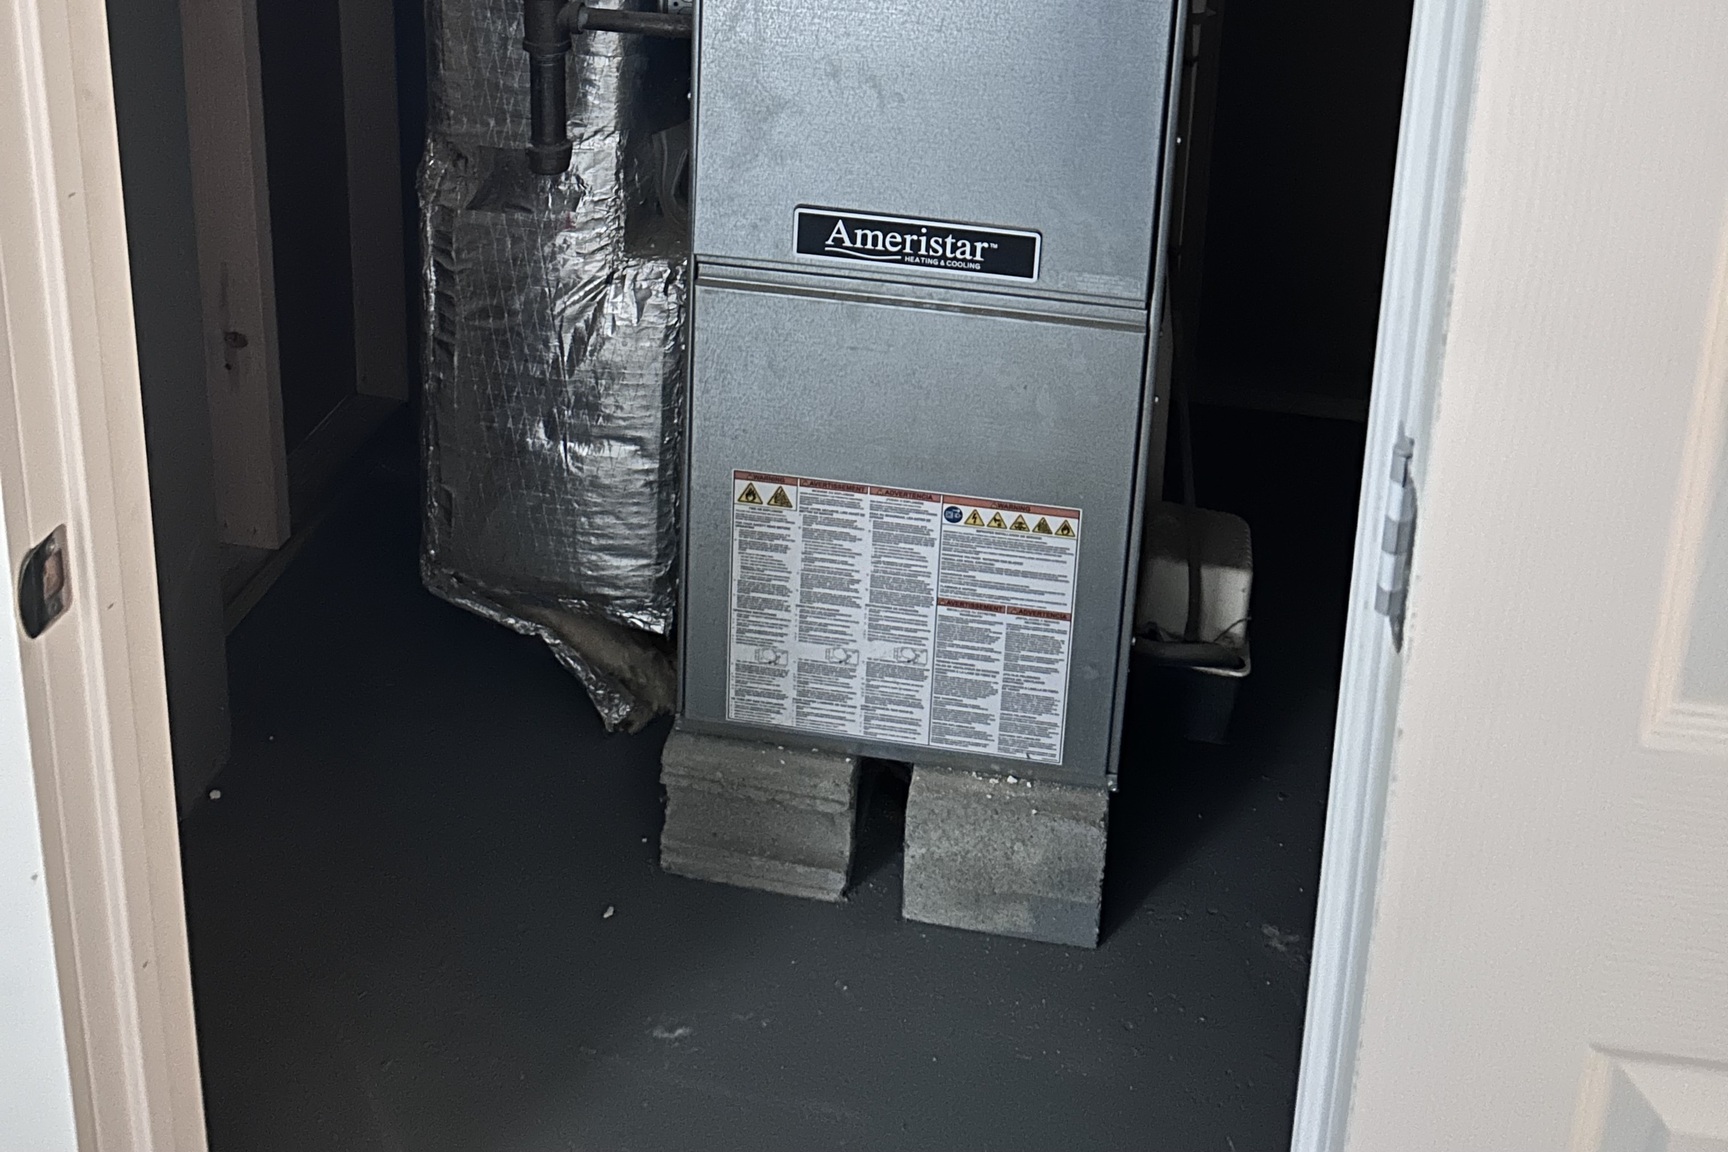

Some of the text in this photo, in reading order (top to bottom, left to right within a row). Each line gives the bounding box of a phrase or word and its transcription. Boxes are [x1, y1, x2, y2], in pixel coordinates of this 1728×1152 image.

[825, 218, 989, 262] Ameristar
[904, 255, 939, 266] HEATING
[946, 260, 981, 270] COOLING
[753, 475, 786, 484] WARNING
[809, 480, 866, 493] AVERTISSEMENT
[884, 489, 934, 501] ADVERTENCIA
[996, 503, 1031, 513] WARNING
[946, 599, 1003, 613] AVERTISSEMENT
[1018, 608, 1068, 620] ADVERTENCIA
